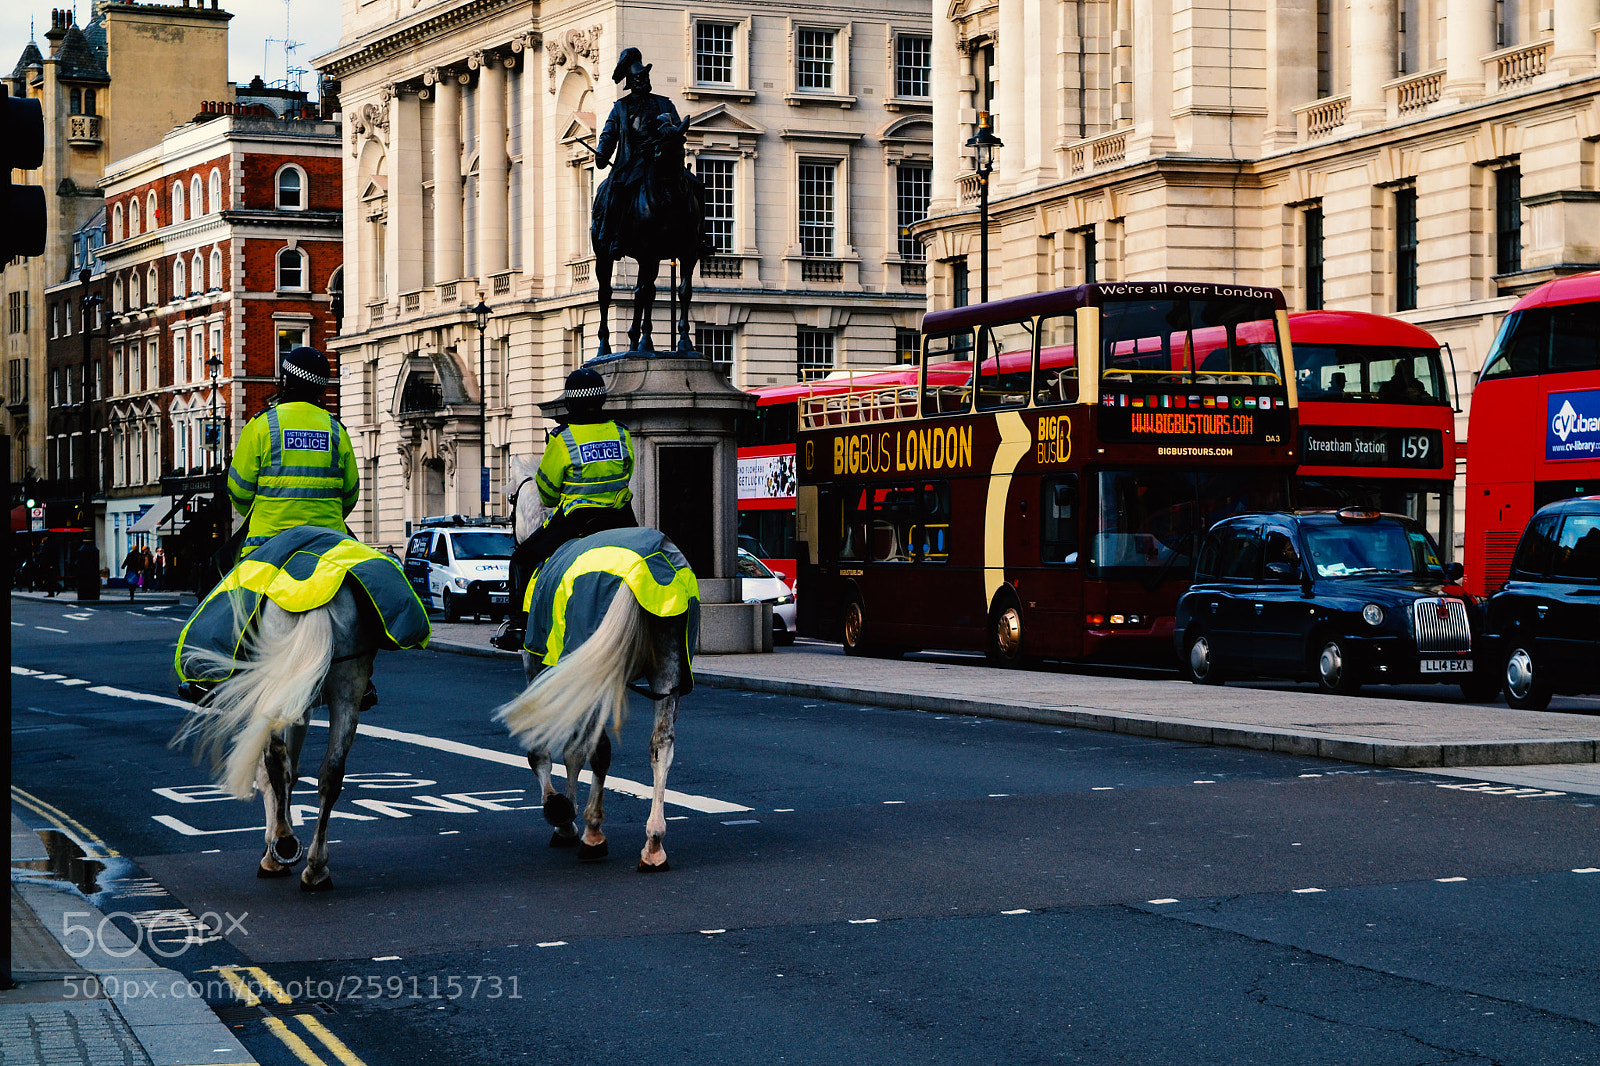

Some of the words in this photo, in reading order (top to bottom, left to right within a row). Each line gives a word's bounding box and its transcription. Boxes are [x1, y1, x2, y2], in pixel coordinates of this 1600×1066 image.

[1099, 284, 1144, 295] We're
[1150, 283, 1168, 293] all
[1173, 285, 1209, 294] over
[1214, 285, 1274, 299] London
[1038, 415, 1057, 441] BIG
[1131, 412, 1254, 435] WWW.BIGBUSTOURS.COM
[286, 431, 327, 439] METROPOLITAN
[287, 437, 327, 449] POLICE
[582, 442, 618, 452] METROPOLITAN
[896, 424, 973, 472] LONDON
[1037, 441, 1057, 464] BUS
[1157, 447, 1233, 456] BIGBUSTOURS.COM
[1308, 436, 1352, 453] Streatham
[1354, 437, 1386, 454] Station
[1401, 436, 1430, 459] 159
[583, 447, 620, 461] POLICE
[1426, 660, 1448, 671] LL14
[1450, 660, 1468, 671] EXA
[151, 789, 545, 836] LANE
